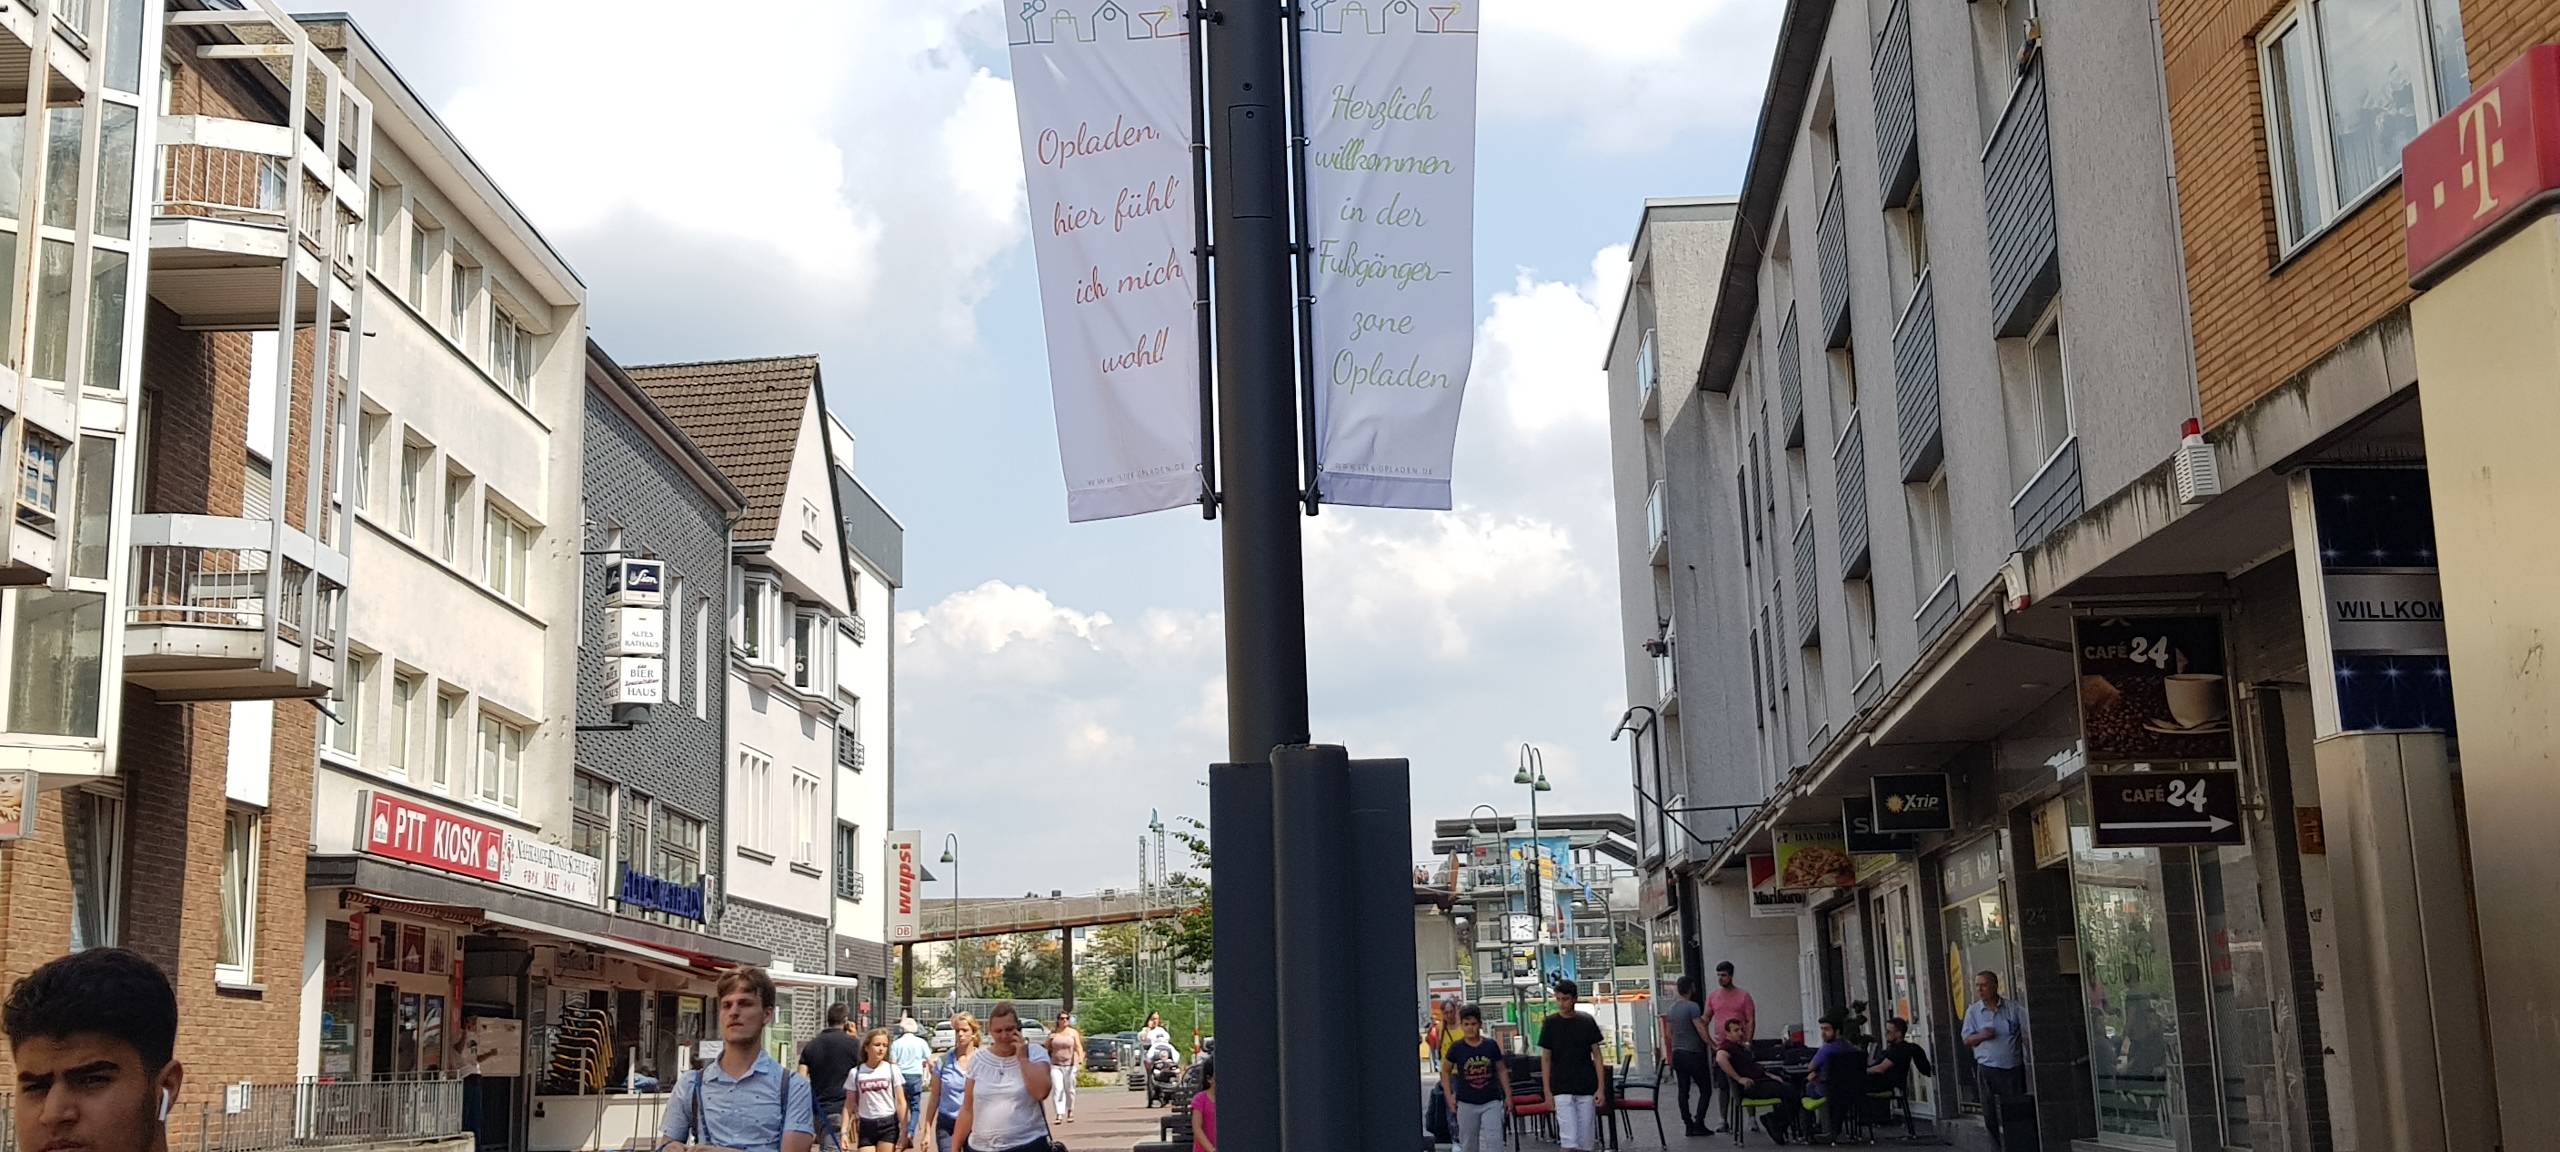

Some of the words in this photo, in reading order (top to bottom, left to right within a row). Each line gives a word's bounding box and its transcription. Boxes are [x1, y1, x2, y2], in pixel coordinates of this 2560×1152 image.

[1332, 84, 1439, 130] Herzlich
[1314, 138, 1456, 174] willkommen
[1054, 201, 1105, 236] hier
[1340, 197, 1367, 222] in
[1376, 192, 1428, 227] der
[1075, 265, 1108, 304] ich
[1118, 247, 1184, 293] mich
[1319, 239, 1452, 290] Fußgänger-
[1349, 311, 1416, 341] zone
[1102, 327, 1170, 373] wohl!
[1333, 348, 1449, 395] Opladen
[625, 640, 660, 648] RATHAUS
[2084, 641, 2128, 660] CAFÉ
[2129, 636, 2168, 669] 24
[630, 669, 655, 678] BIER
[627, 687, 657, 697] HAUS
[2121, 784, 2165, 803] CAFÉ
[2167, 778, 2207, 813] 24
[394, 806, 427, 853] PTT
[433, 818, 483, 868] KIOSK
[899, 842, 916, 914] wupsi
[1753, 886, 1807, 905] Marlboro
[896, 927, 910, 936] DB
